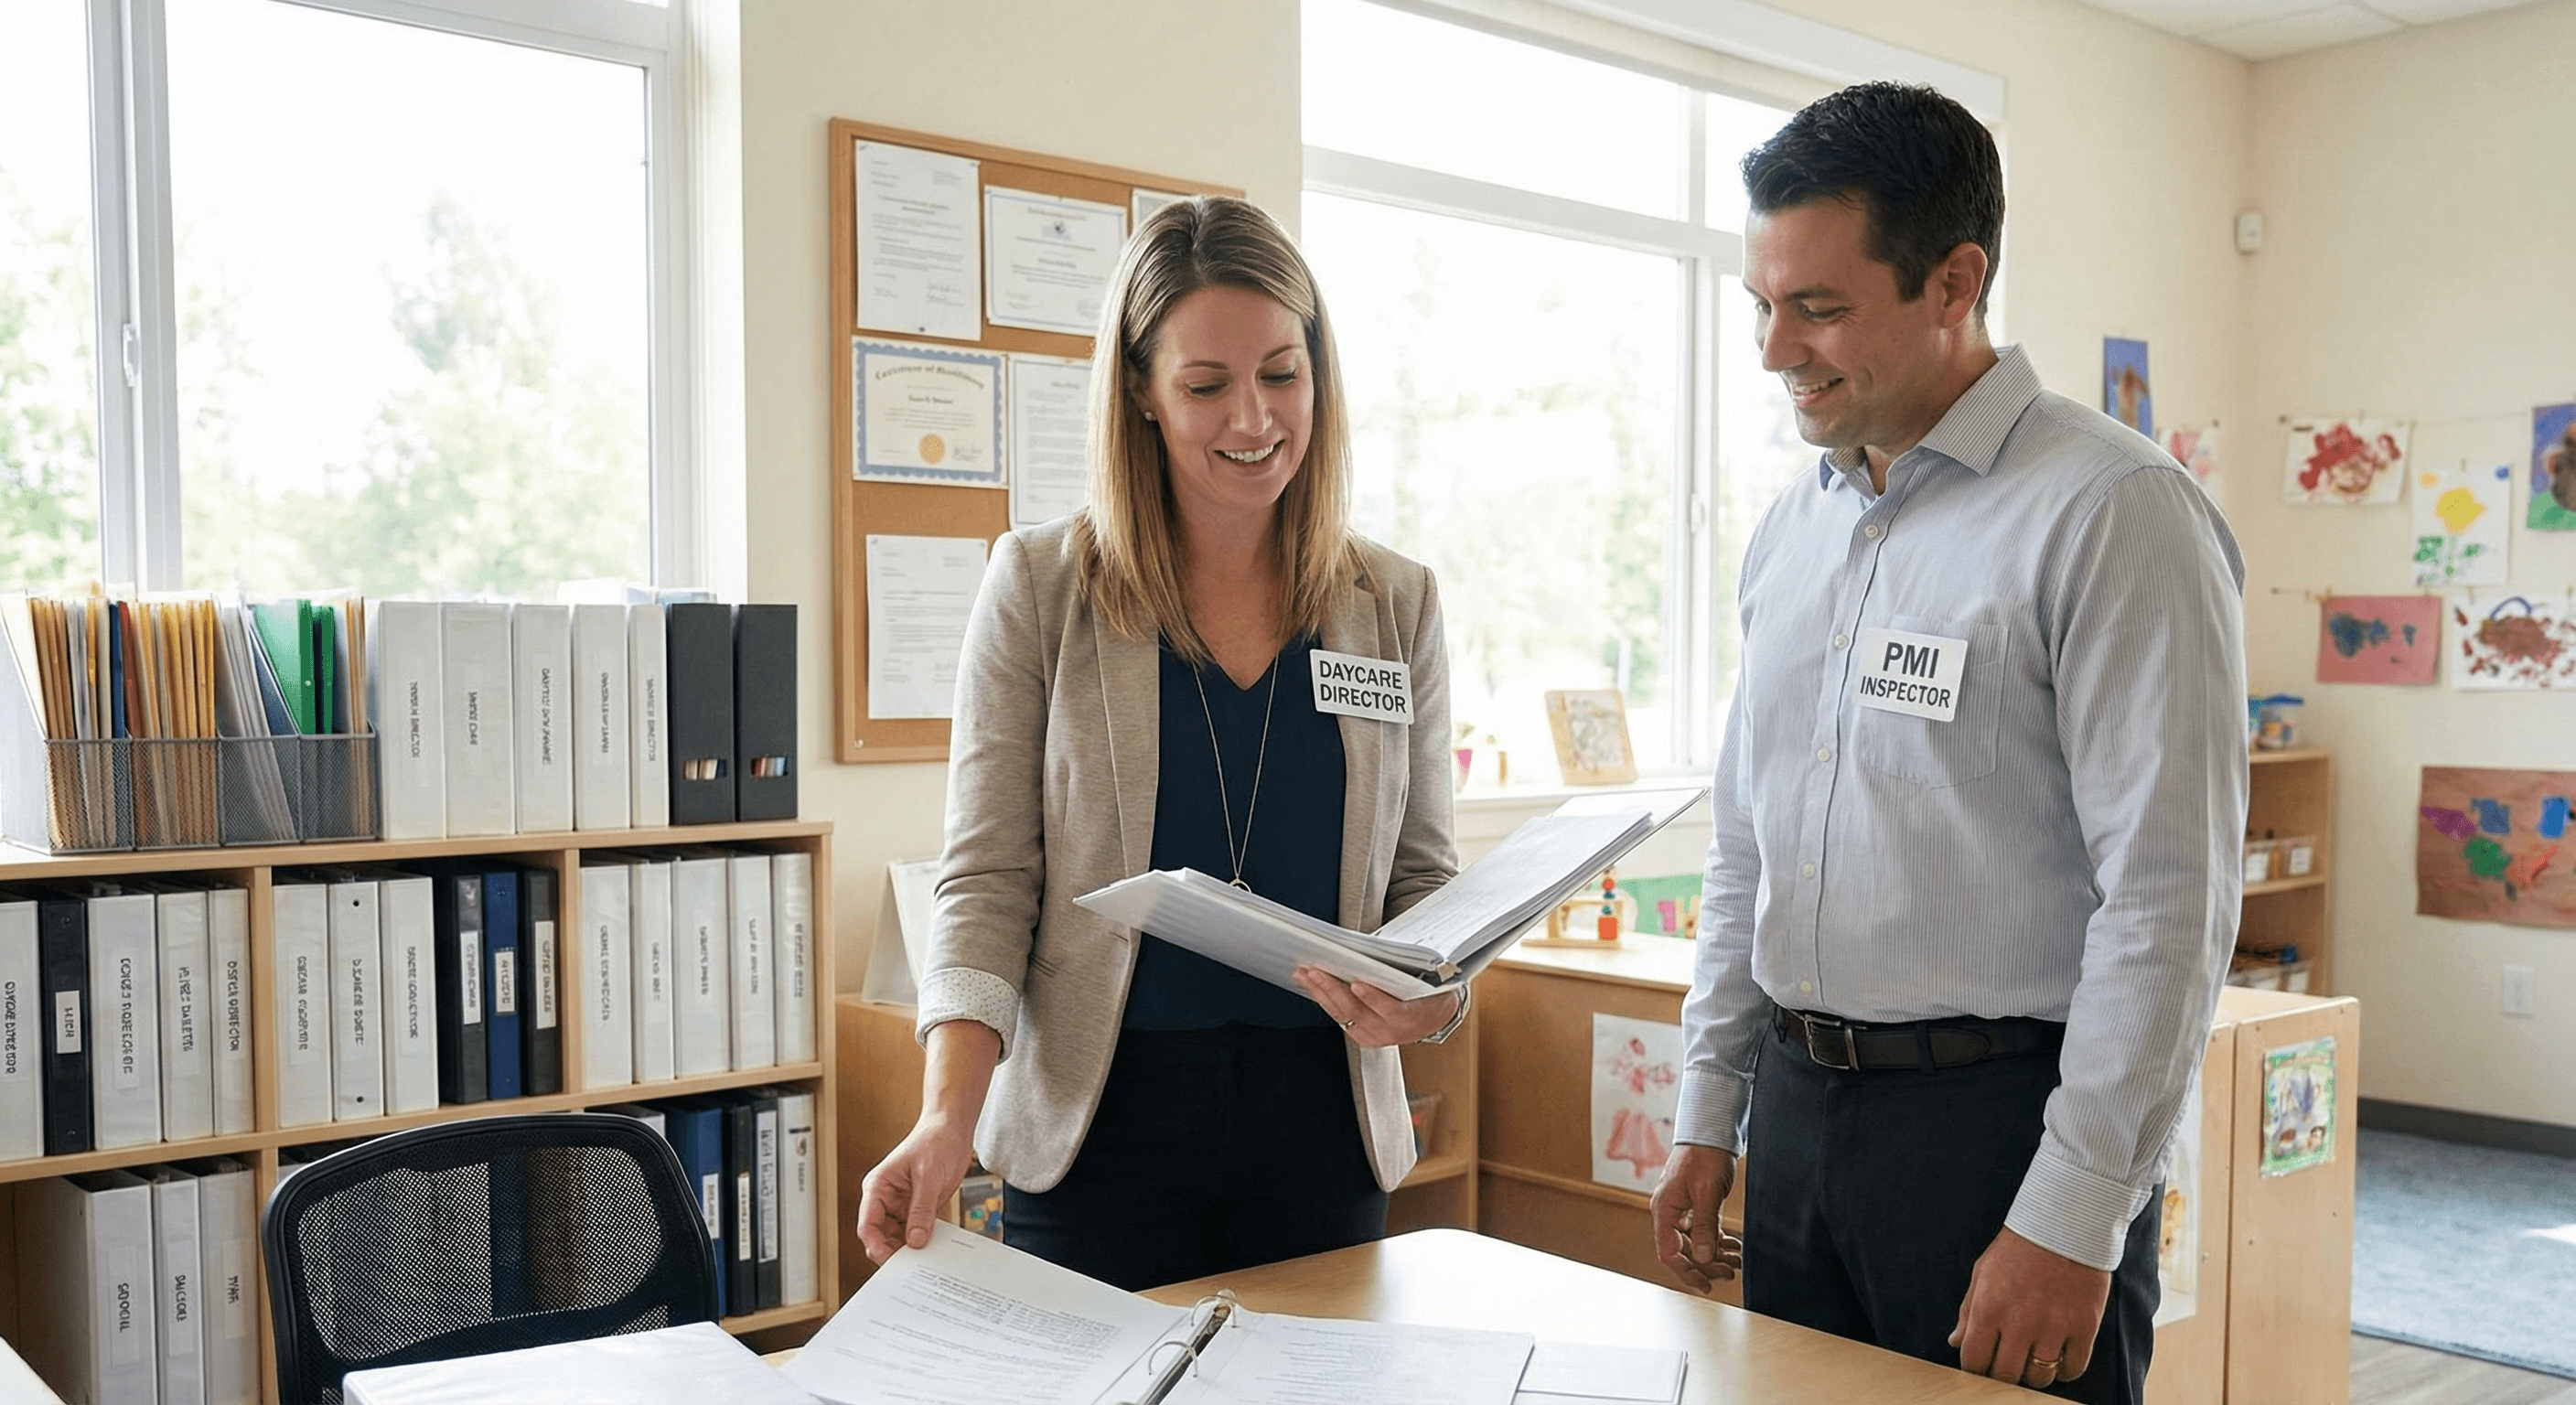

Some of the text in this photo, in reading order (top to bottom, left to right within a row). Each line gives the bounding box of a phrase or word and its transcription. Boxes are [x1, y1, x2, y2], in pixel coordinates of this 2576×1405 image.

[1319, 660, 1403, 690] DAYCARE
[1883, 641, 1939, 679] PMI
[1320, 683, 1406, 714] DIRECTOR
[1860, 675, 1950, 709] INSPECTOR
